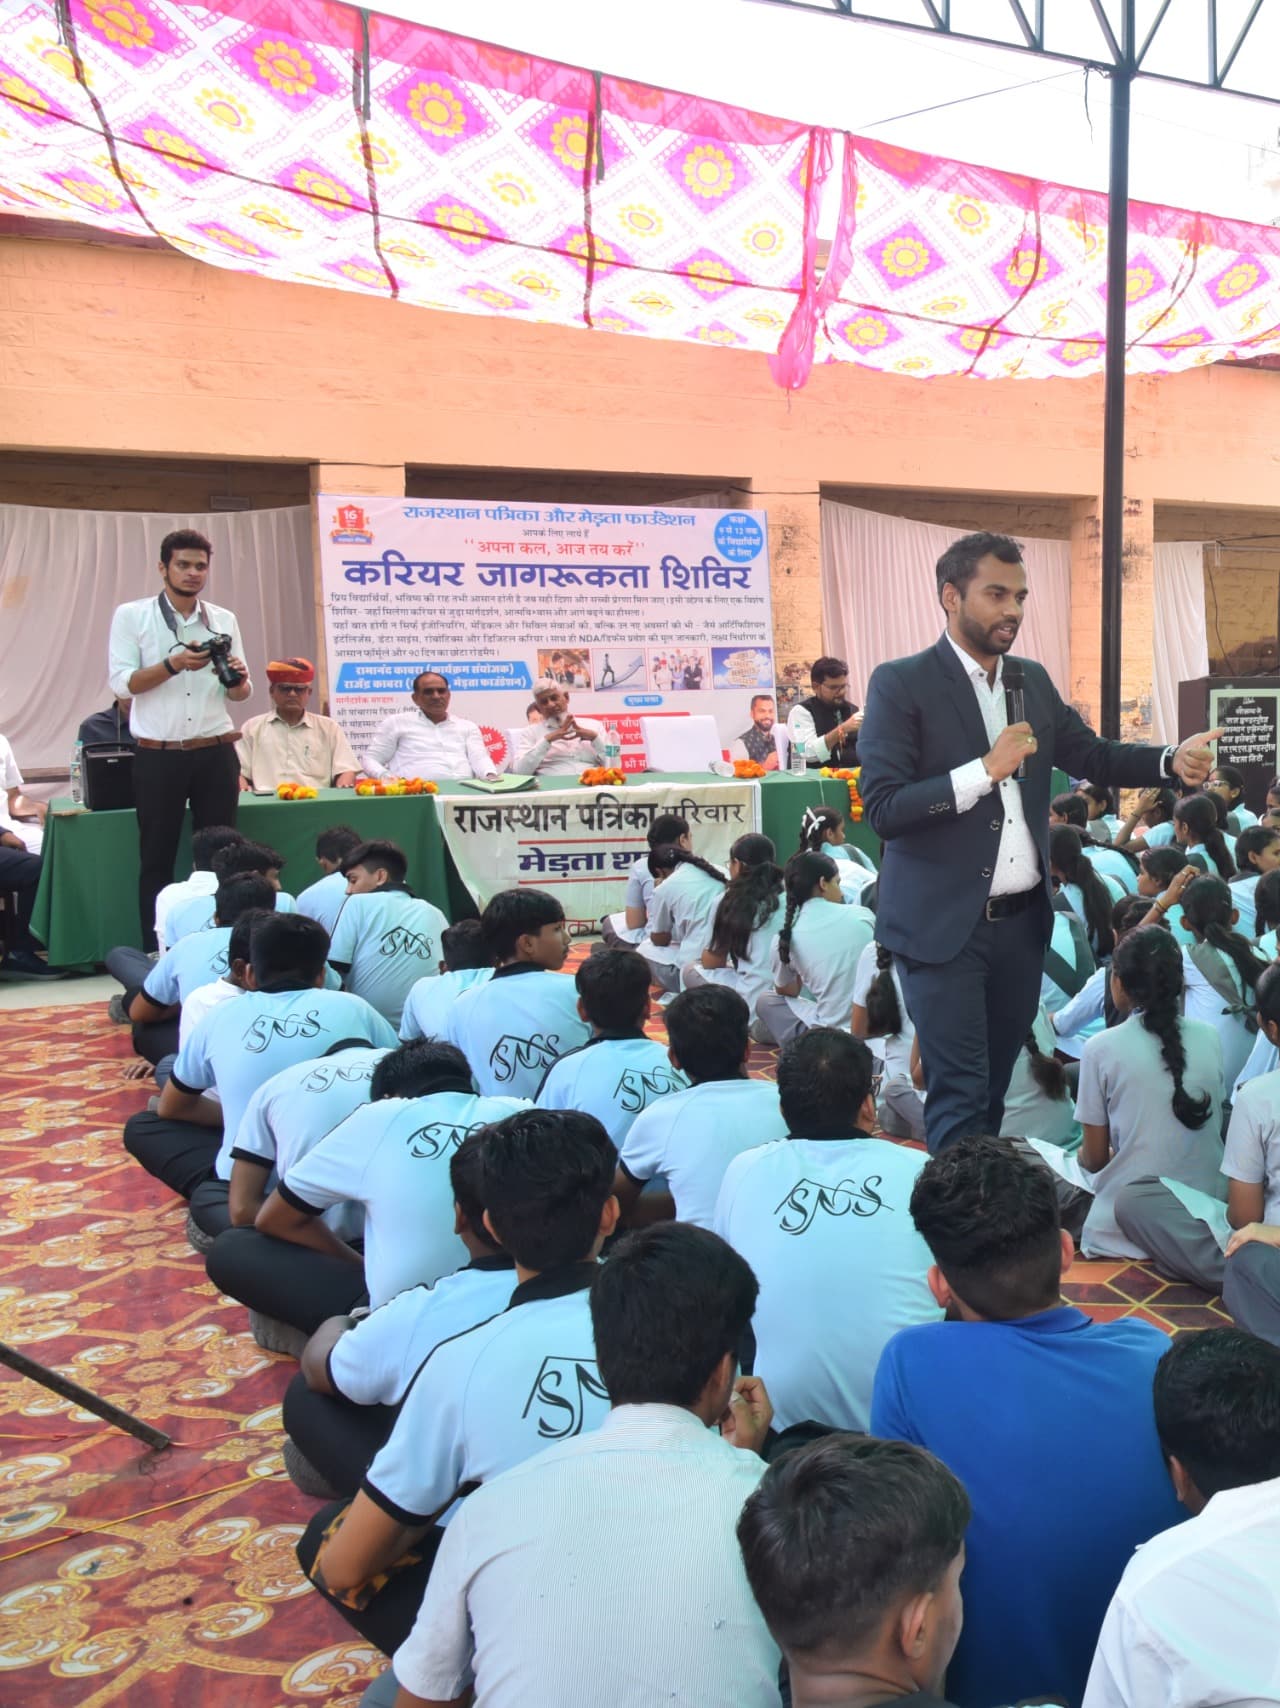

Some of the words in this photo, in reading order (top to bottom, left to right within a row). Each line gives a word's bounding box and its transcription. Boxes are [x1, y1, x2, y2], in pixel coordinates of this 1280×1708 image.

[403, 506, 480, 520] राजस्थान
[485, 505, 539, 522] पत्रिका
[543, 507, 576, 523] और
[579, 509, 622, 527] मेड़ता
[342, 549, 465, 587] करियर
[476, 563, 650, 588] जागरूकता
[660, 555, 752, 590] शिविर
[557, 543, 585, 556] आज
[590, 544, 608, 556] तय
[454, 803, 570, 832] राजस्थान
[576, 792, 658, 831] पत्रिका
[662, 798, 746, 823] परिवार
[518, 848, 606, 877] मेड़ता
[242, 1009, 330, 1053] SNS
[773, 1175, 895, 1236] SNS
